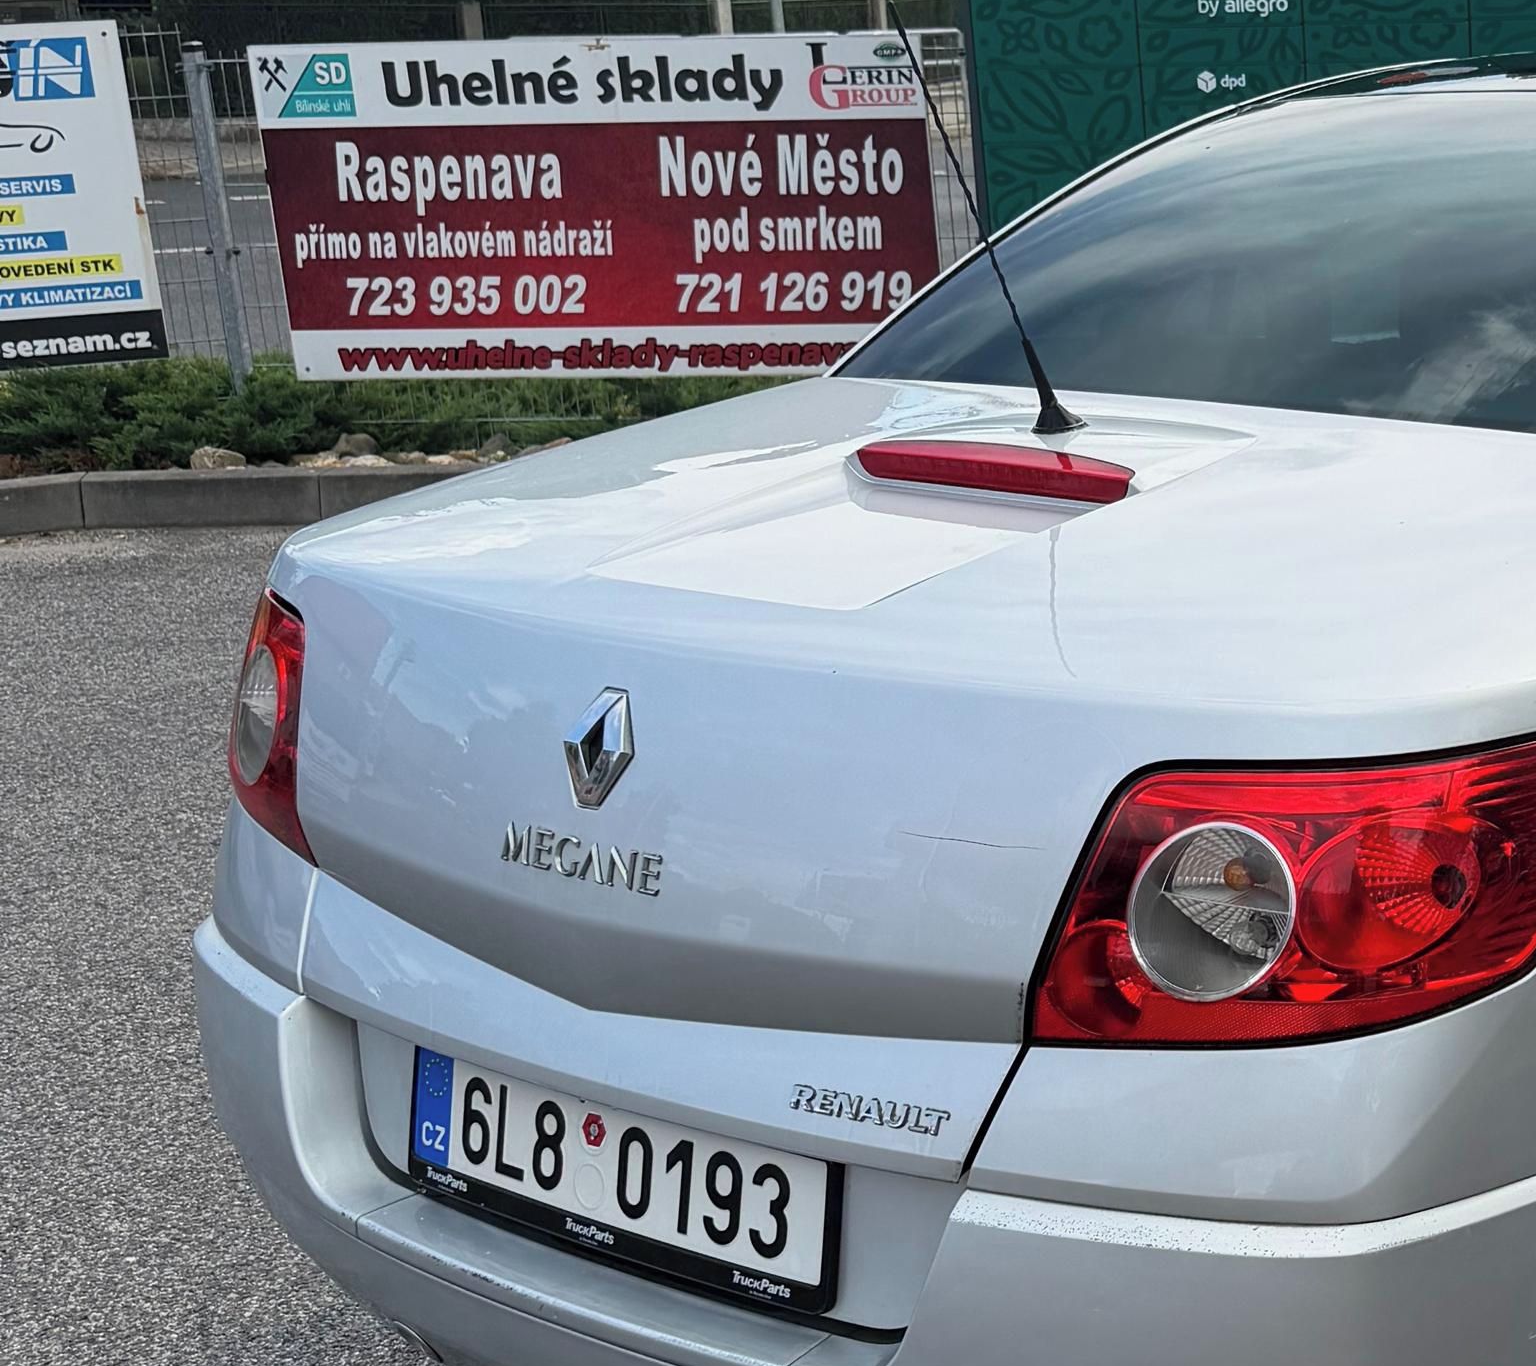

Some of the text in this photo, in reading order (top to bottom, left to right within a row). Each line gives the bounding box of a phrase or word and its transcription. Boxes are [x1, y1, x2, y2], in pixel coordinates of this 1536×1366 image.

[314, 62, 346, 85] SD
[381, 54, 783, 111] Uhelné sklady
[809, 65, 916, 110] GROUP
[1220, 73, 1246, 91] dpd
[335, 141, 562, 216] Raspenava
[659, 134, 903, 197] Nové Město
[0, 179, 62, 195] SERVIS
[295, 219, 613, 268] přímo na vlakovém nádraží
[694, 205, 882, 263] pod smrkem
[81, 259, 115, 273] STK
[21, 283, 132, 305] KLIMATIZACÍ
[346, 274, 587, 316] 723 935 002
[675, 270, 912, 313] 721 126 919
[2, 331, 152, 359] seznam.cz
[501, 821, 663, 897] MEGANE
[790, 1085, 951, 1136] RENAULT
[421, 1121, 445, 1151] CZ
[461, 1076, 790, 1259] 6L8 0193
[565, 1217, 614, 1245] TruckParts
[732, 1270, 791, 1298] TruckParts
